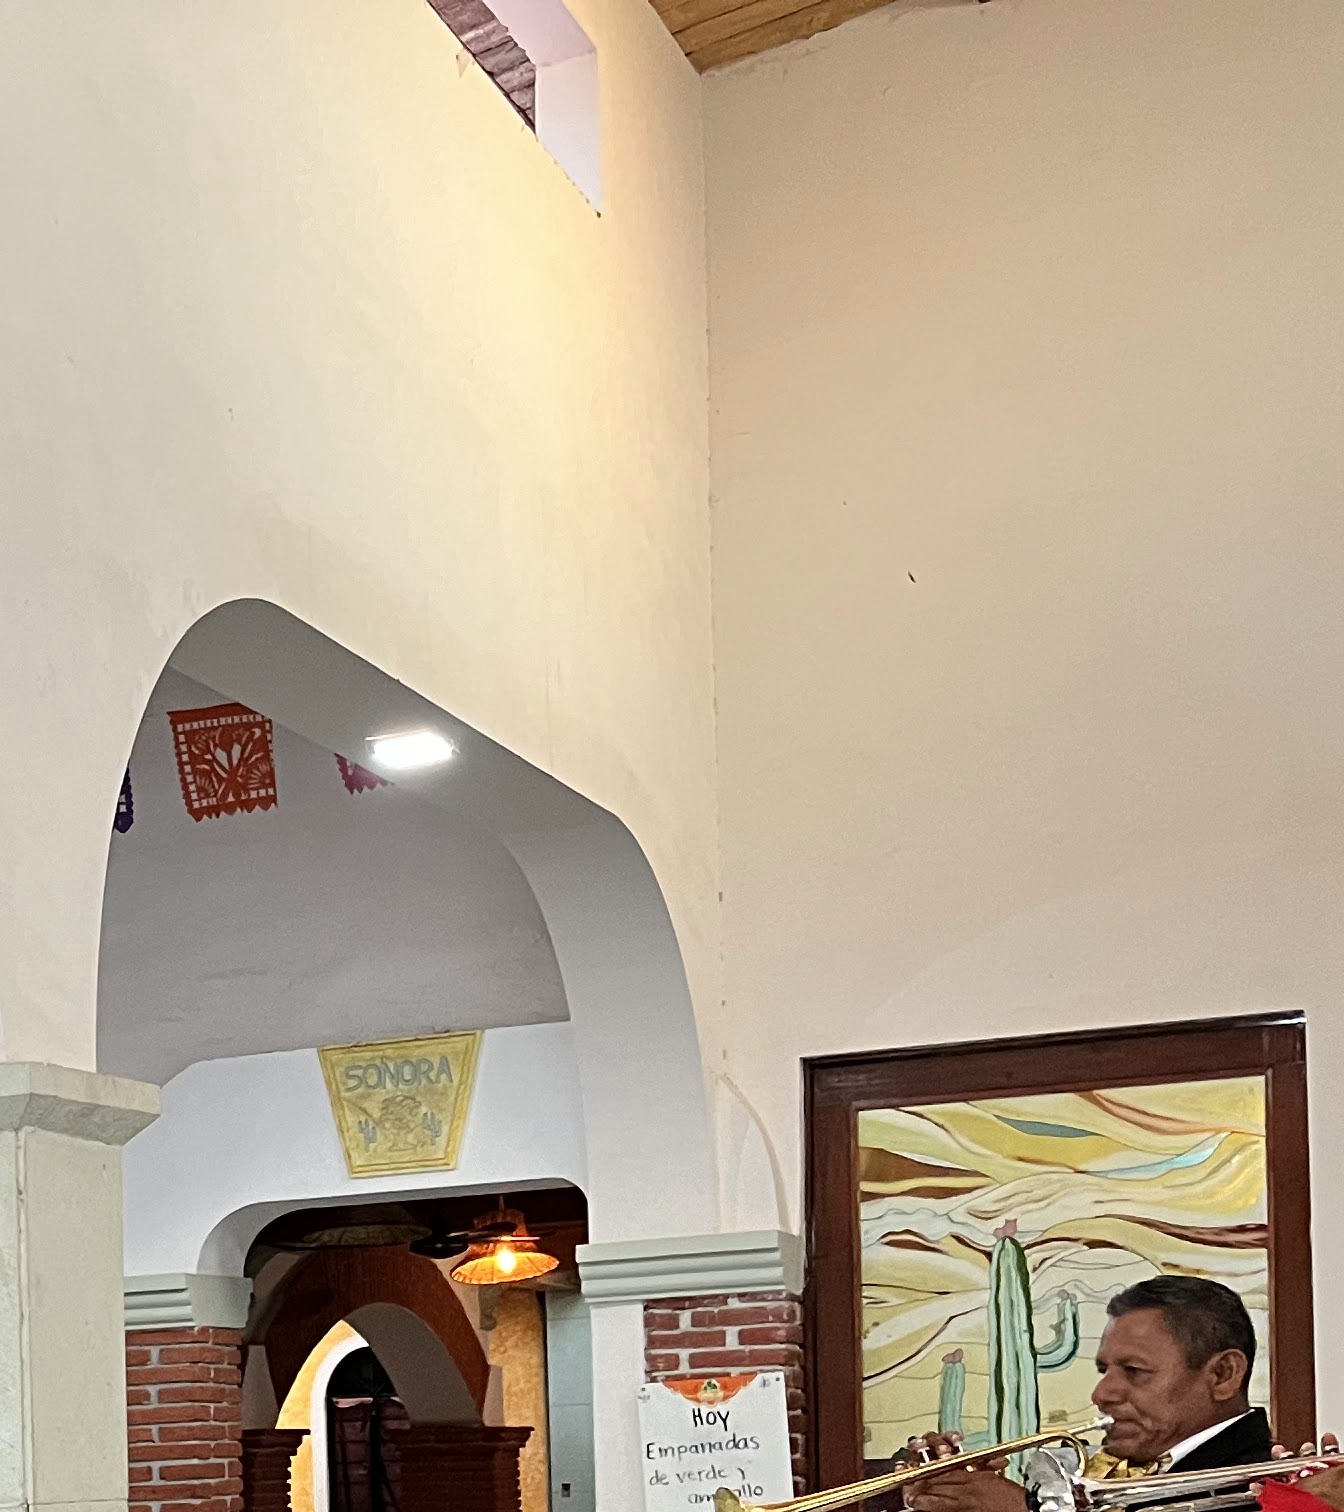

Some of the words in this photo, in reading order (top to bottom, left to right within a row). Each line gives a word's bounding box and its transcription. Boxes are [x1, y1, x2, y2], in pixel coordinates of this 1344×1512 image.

[343, 1055, 453, 1093] SONORA
[646, 1432, 760, 1462] Empanadas
[649, 1470, 670, 1486] de
[676, 1464, 727, 1484] verde
